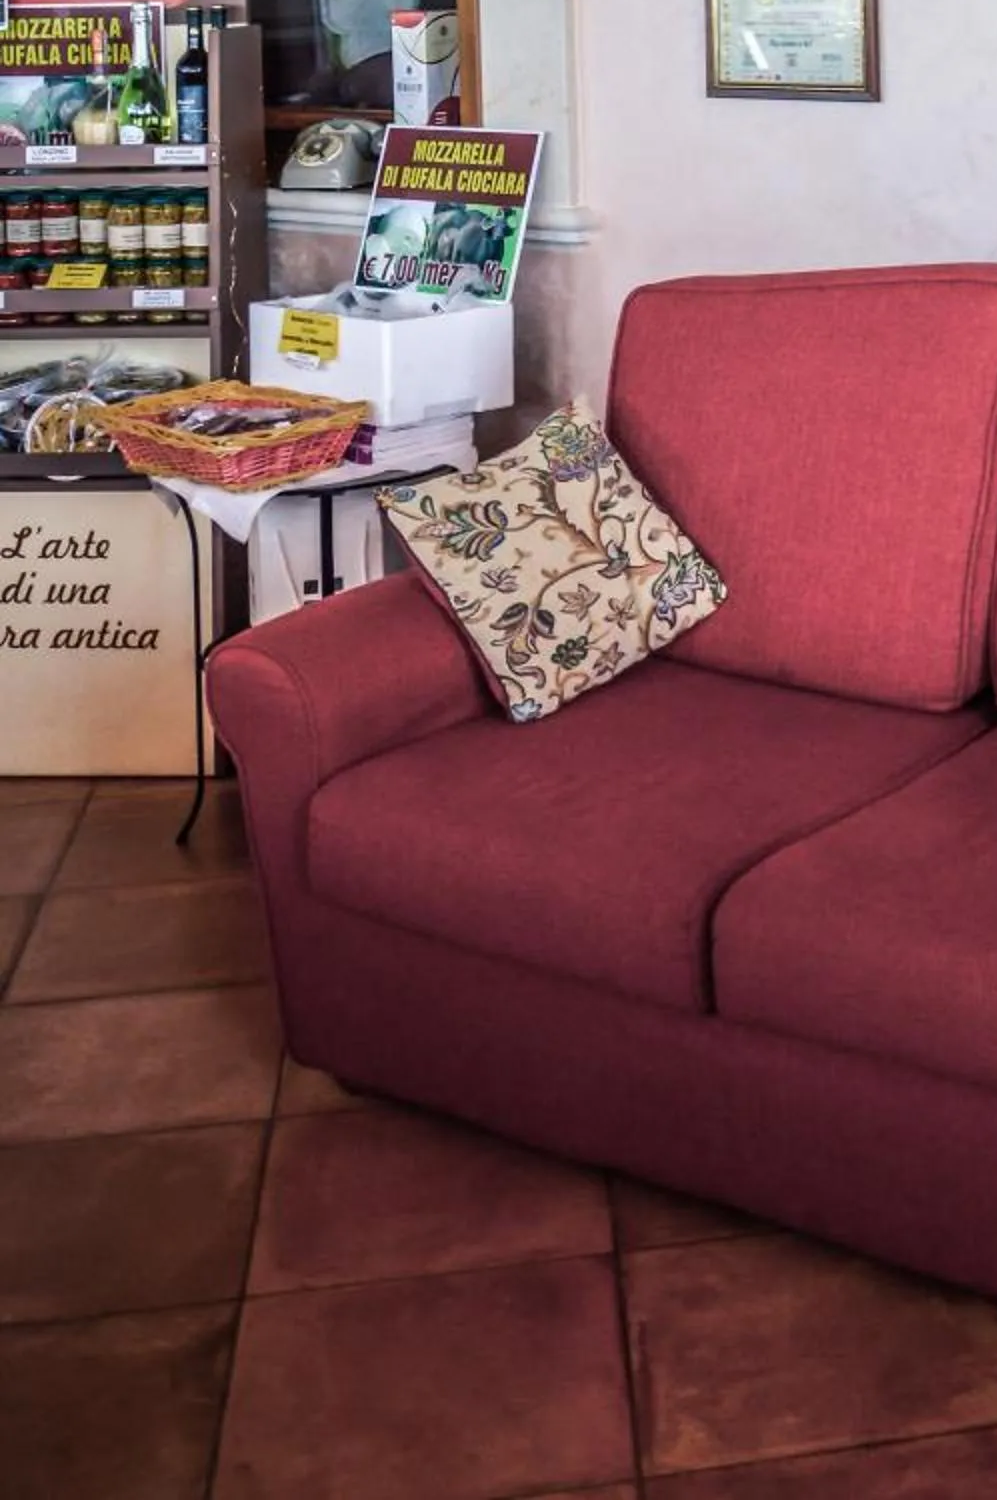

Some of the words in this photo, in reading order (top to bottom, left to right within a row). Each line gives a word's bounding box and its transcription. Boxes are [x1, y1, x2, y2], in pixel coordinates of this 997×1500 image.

[0, 43, 63, 67] UFALA
[413, 139, 506, 167] MOZZARELLA
[382, 166, 398, 187] DI
[400, 166, 454, 191] BUFALA
[457, 169, 527, 196] CIOCIARA
[0, 525, 111, 559] L'arte
[0, 571, 37, 605] di
[43, 583, 112, 605] una
[49, 619, 161, 650] antica
